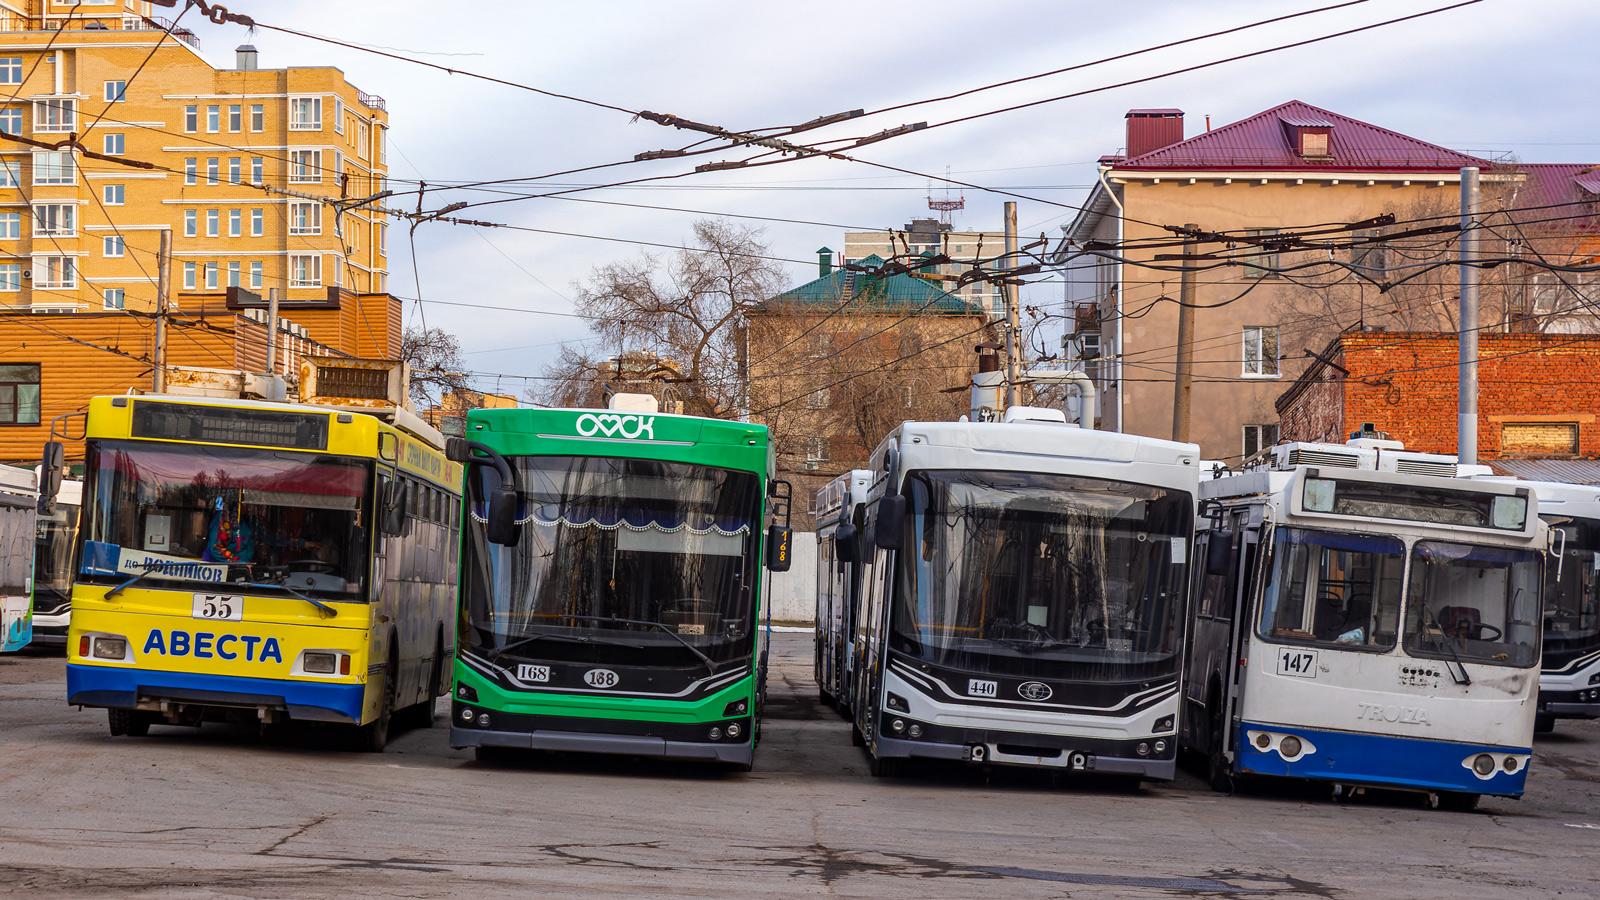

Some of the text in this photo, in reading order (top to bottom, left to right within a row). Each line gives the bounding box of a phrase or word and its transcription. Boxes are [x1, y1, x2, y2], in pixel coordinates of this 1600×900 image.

[780, 531, 788, 561] 168
[203, 595, 232, 618] 55
[143, 629, 282, 663] АВЕСТА
[520, 666, 547, 680] 168
[1283, 652, 1313, 673] 147
[590, 671, 615, 685] 168
[970, 681, 994, 694] 440
